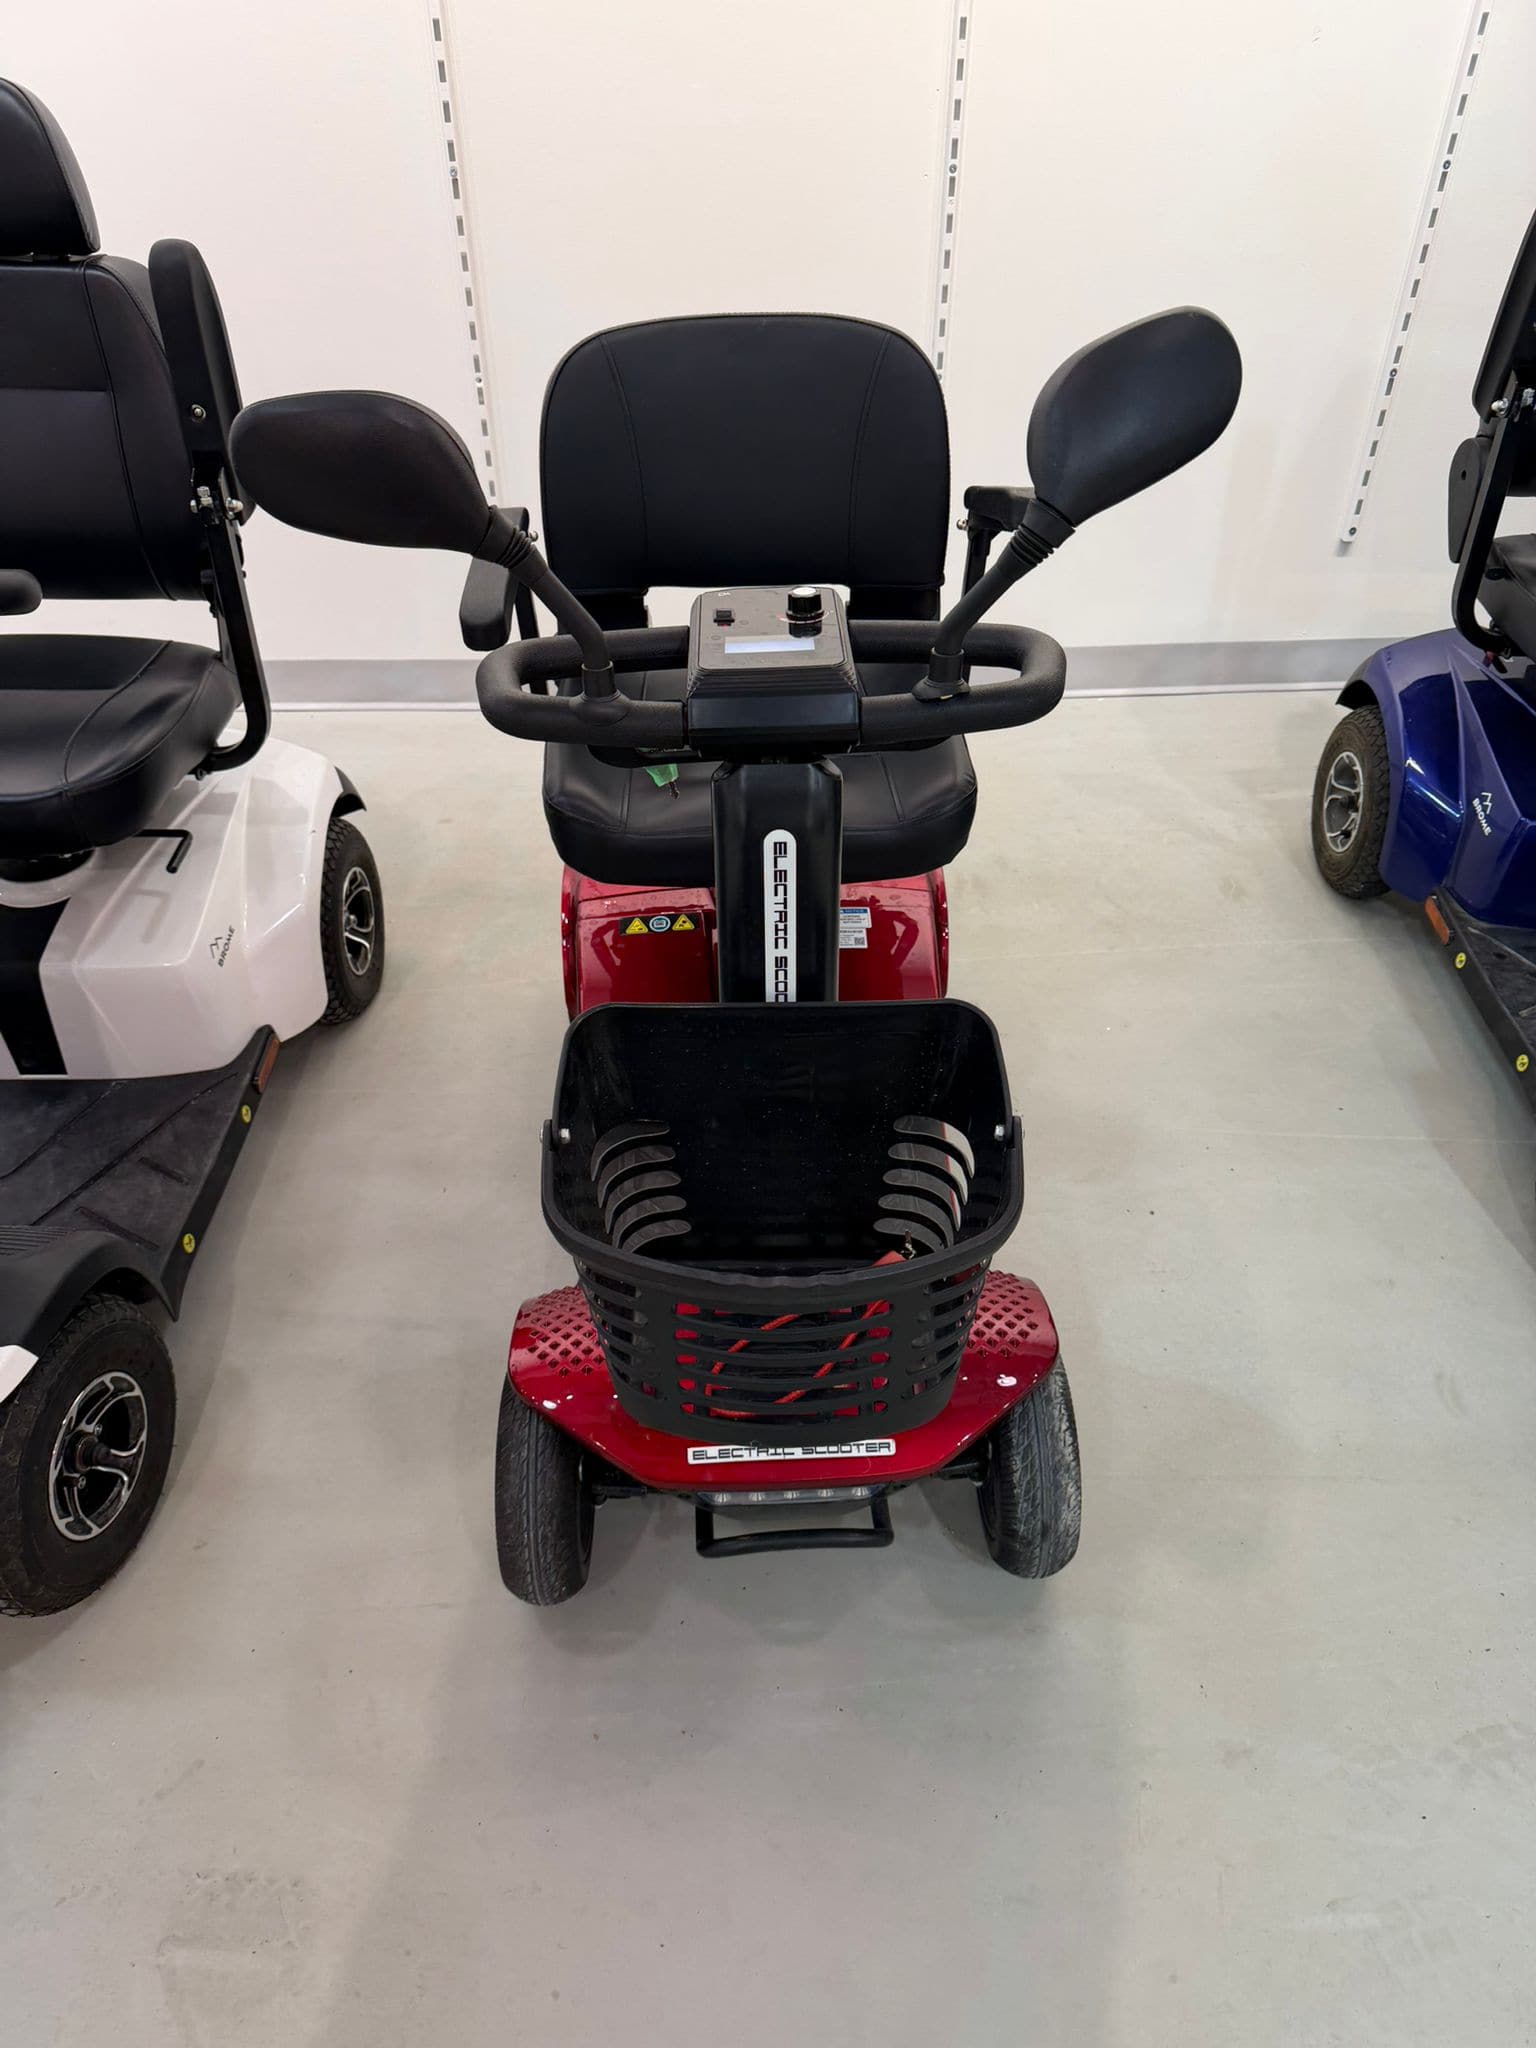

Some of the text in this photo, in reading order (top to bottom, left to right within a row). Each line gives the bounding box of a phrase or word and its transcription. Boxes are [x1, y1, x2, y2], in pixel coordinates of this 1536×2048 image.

[1472, 798, 1492, 836] BROME
[773, 842, 788, 949] ELECTRIC
[218, 925, 236, 968] BROME
[692, 1442, 891, 1460] ELECTRIC SCOOTER
